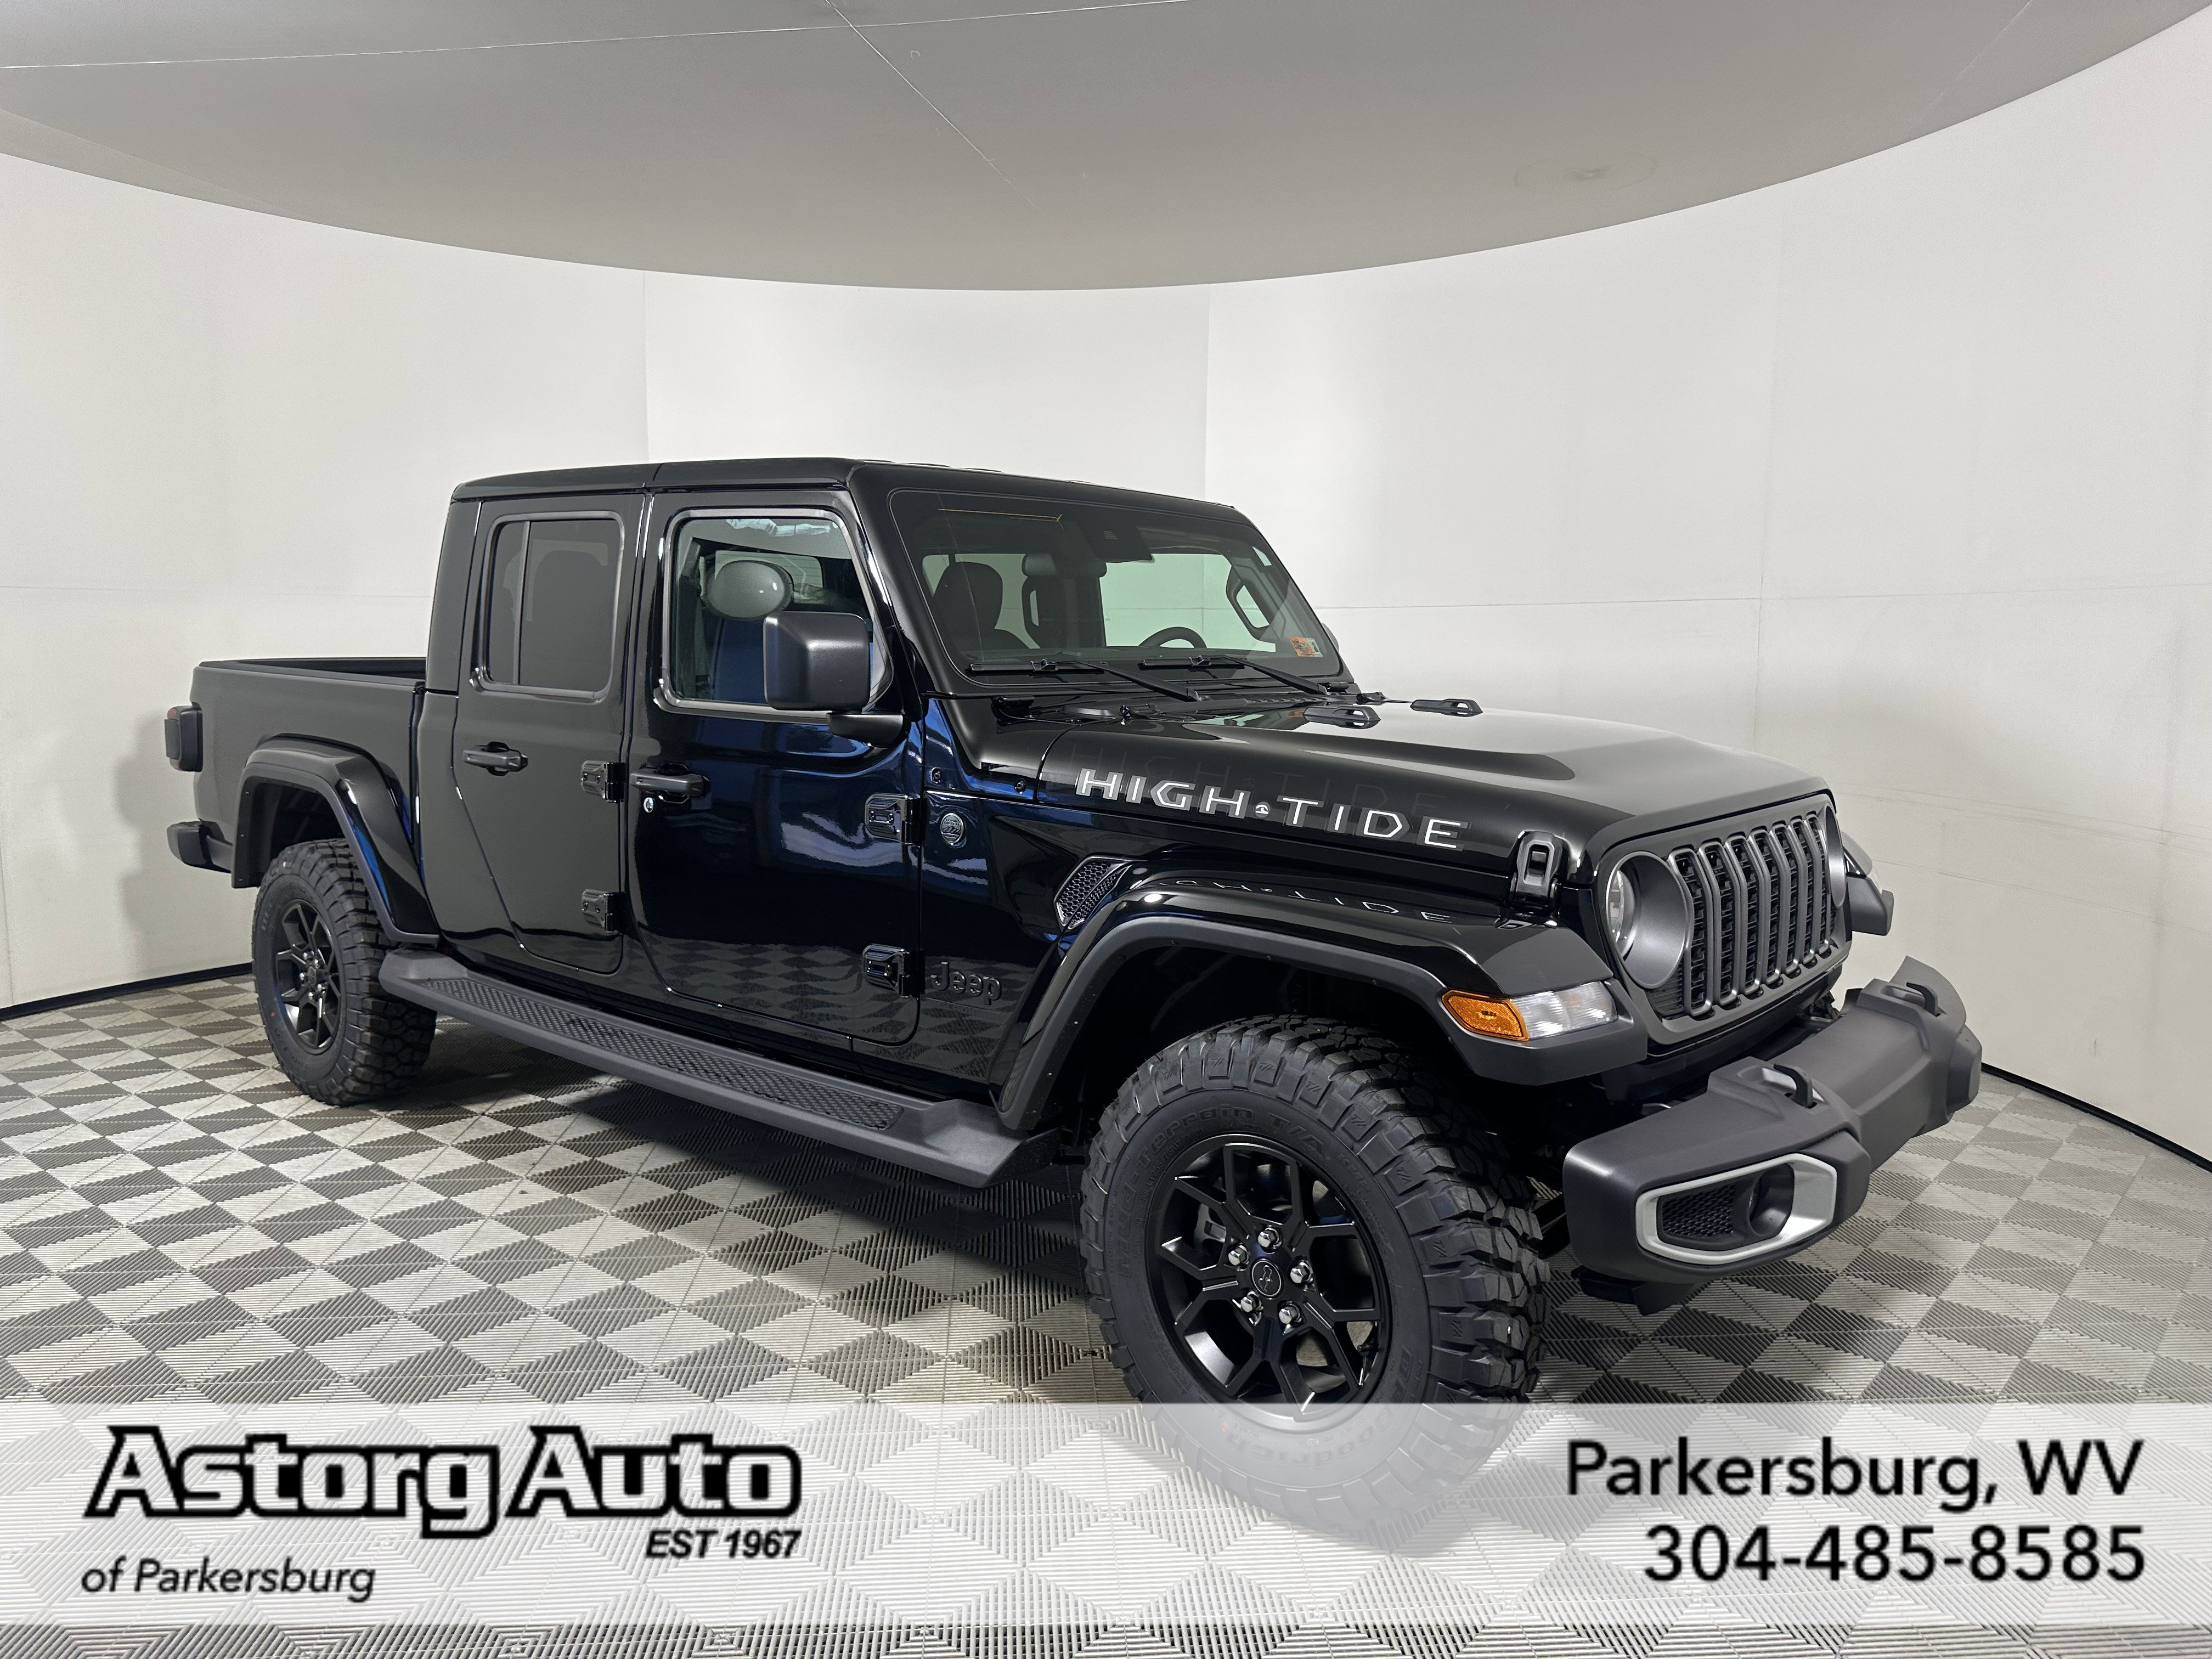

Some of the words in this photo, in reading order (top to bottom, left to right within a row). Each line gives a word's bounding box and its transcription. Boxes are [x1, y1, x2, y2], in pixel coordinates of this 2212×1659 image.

[1075, 768, 1250, 819] HIGH
[1277, 794, 1470, 851] TIDE
[930, 961, 1002, 1005] Jeep
[1268, 1112, 1325, 1157] T/A
